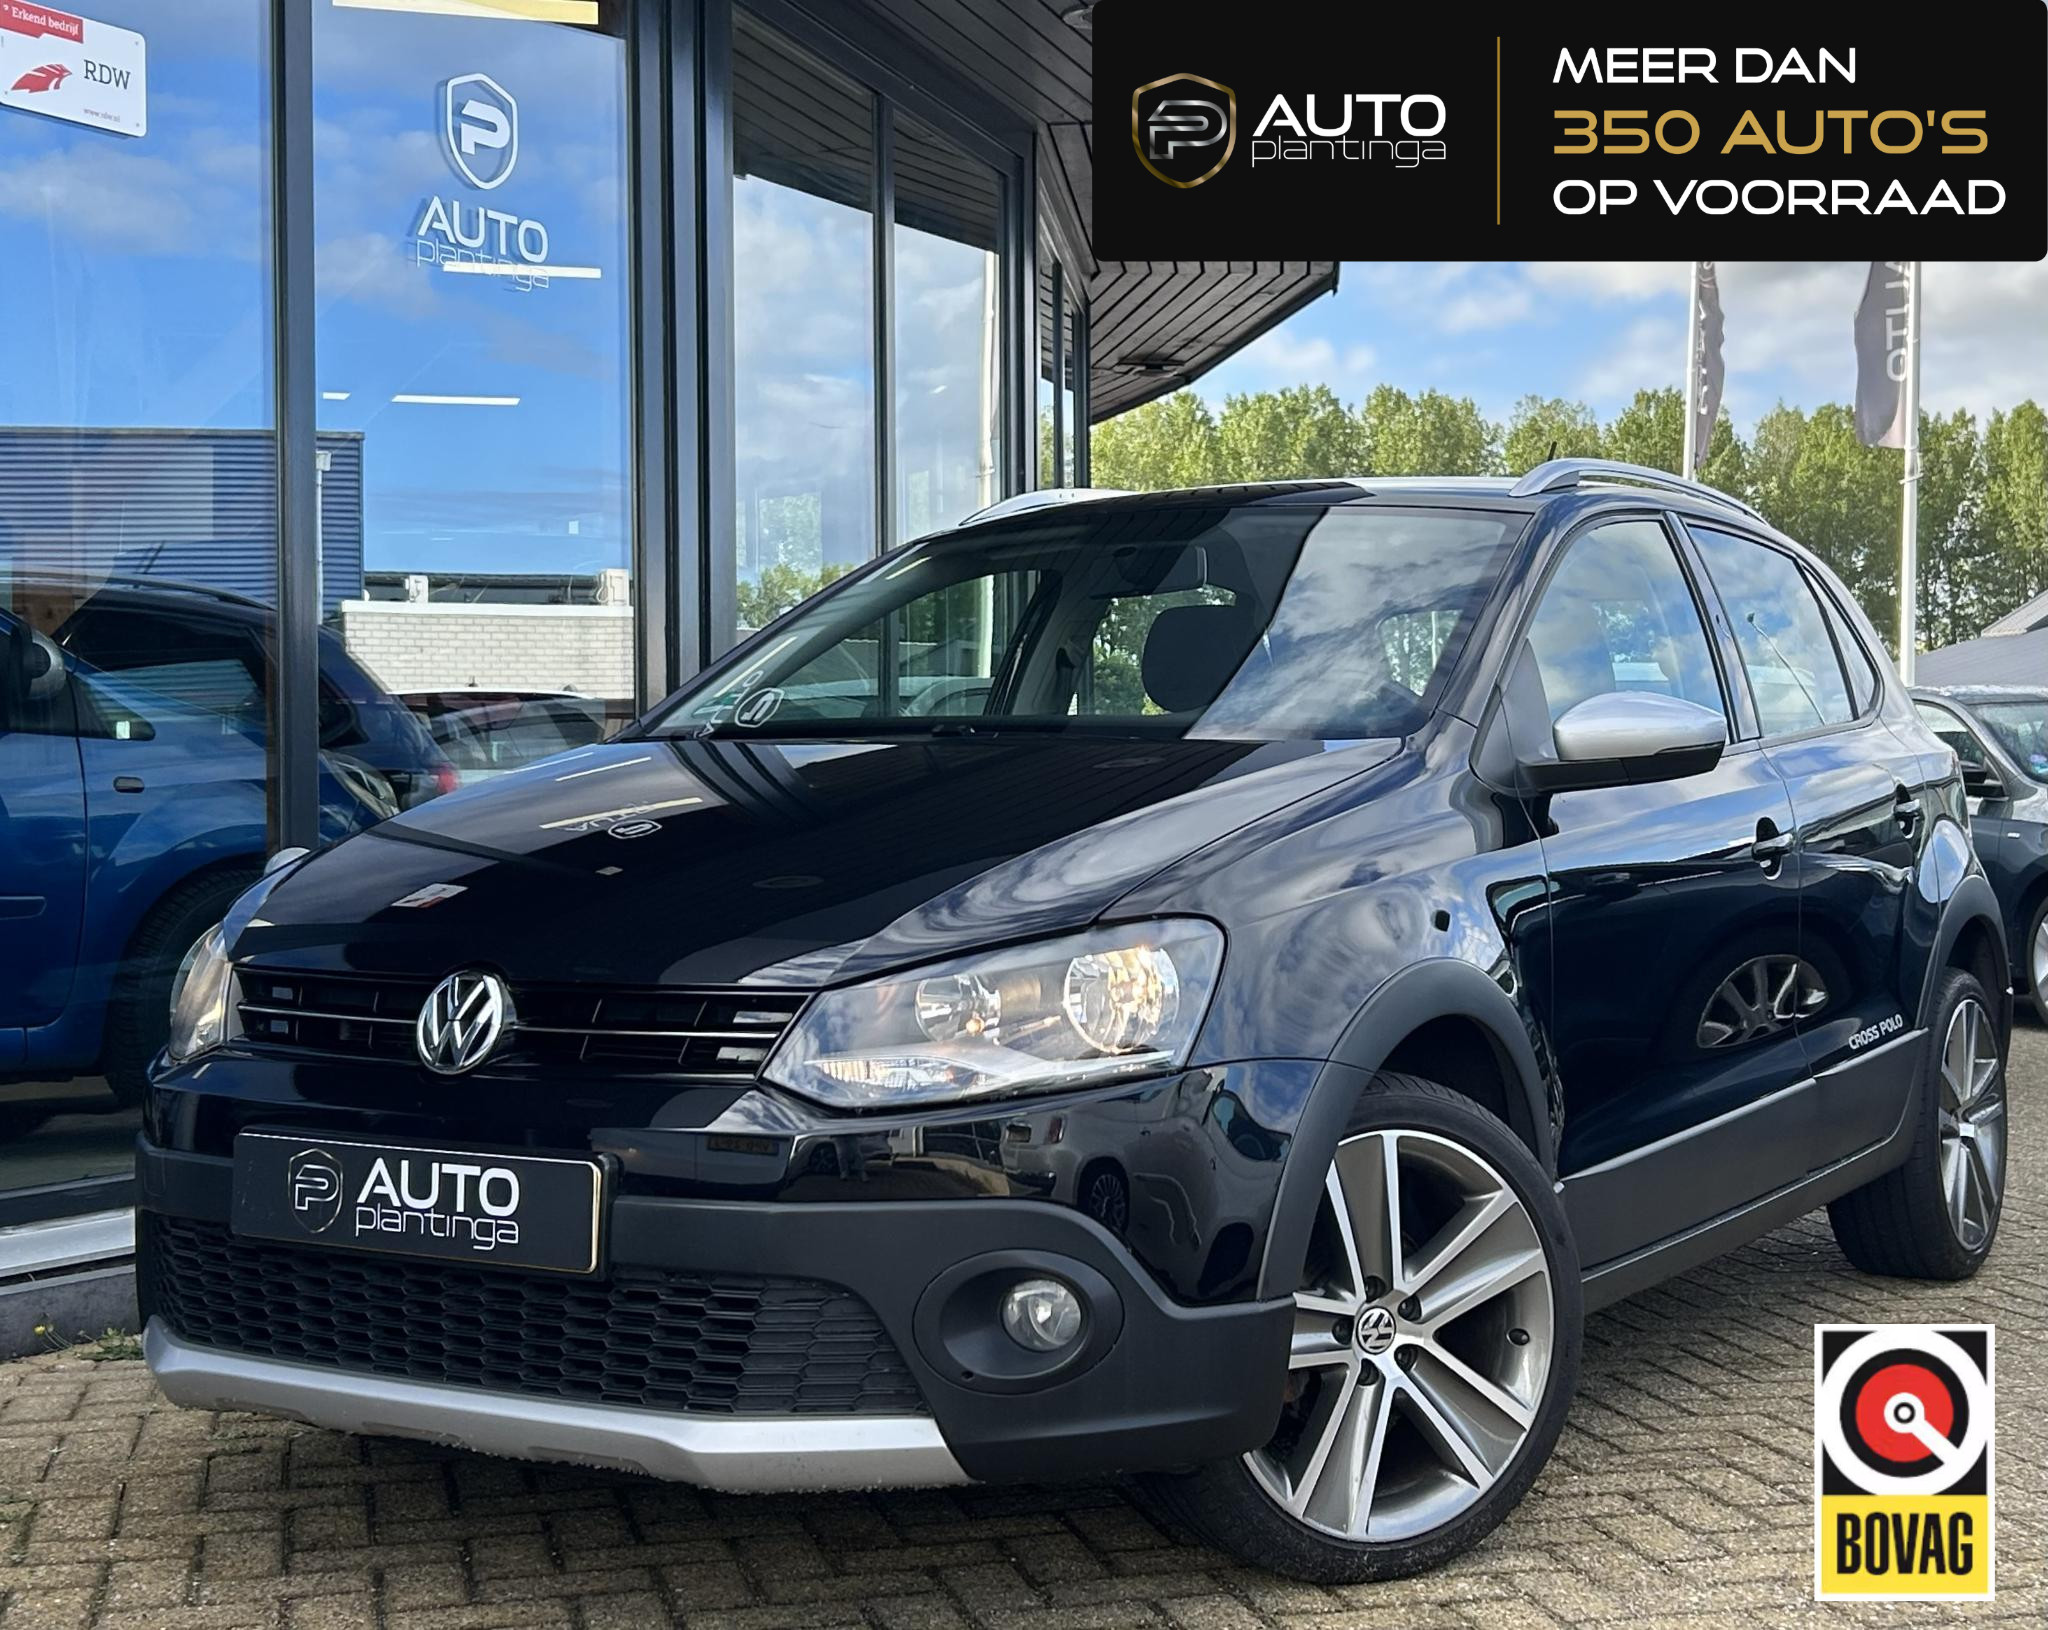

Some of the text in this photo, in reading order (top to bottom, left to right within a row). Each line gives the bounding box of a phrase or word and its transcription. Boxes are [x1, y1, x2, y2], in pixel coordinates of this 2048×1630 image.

[11, 6, 80, 36] Erkend bedrijf
[83, 59, 131, 90] RDW
[417, 195, 549, 264] AUTO
[1848, 1014, 1904, 1050] CROSS POLO
[356, 1157, 520, 1217] AUTO
[355, 1203, 520, 1250] plantinga
